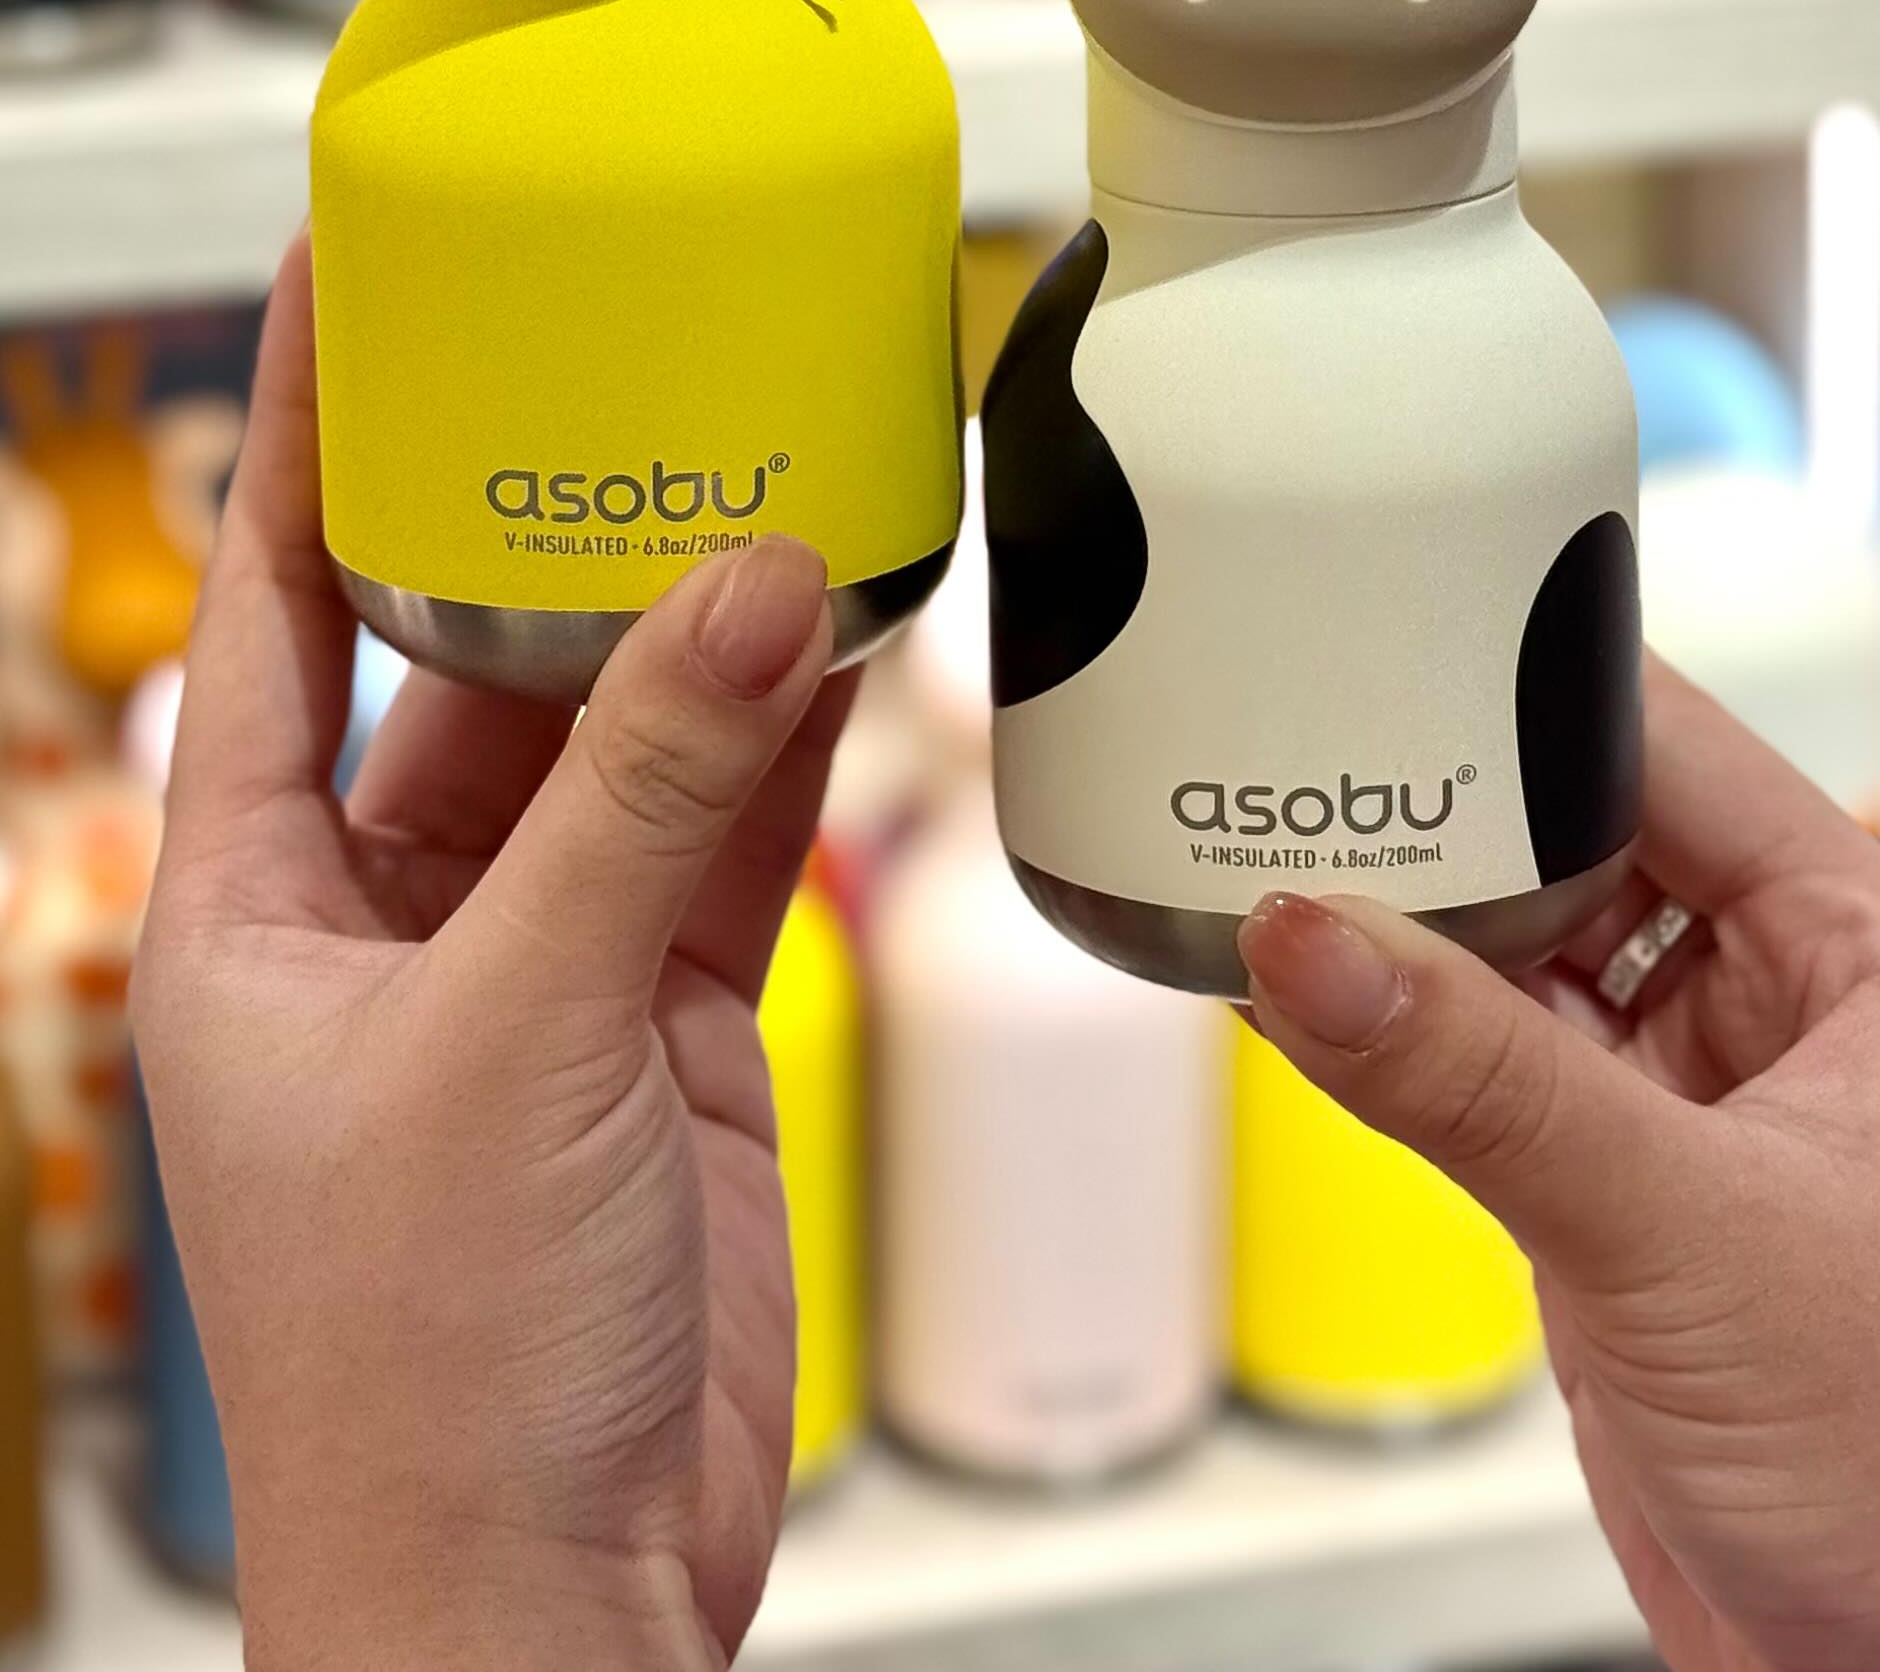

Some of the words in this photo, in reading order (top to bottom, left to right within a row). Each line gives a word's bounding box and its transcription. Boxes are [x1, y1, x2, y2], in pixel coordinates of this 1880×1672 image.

[504, 532, 628, 556] V-INSULATED
[1190, 843, 1316, 869] V-INSULATED
[1331, 842, 1443, 869] 6.8oz/200ml
